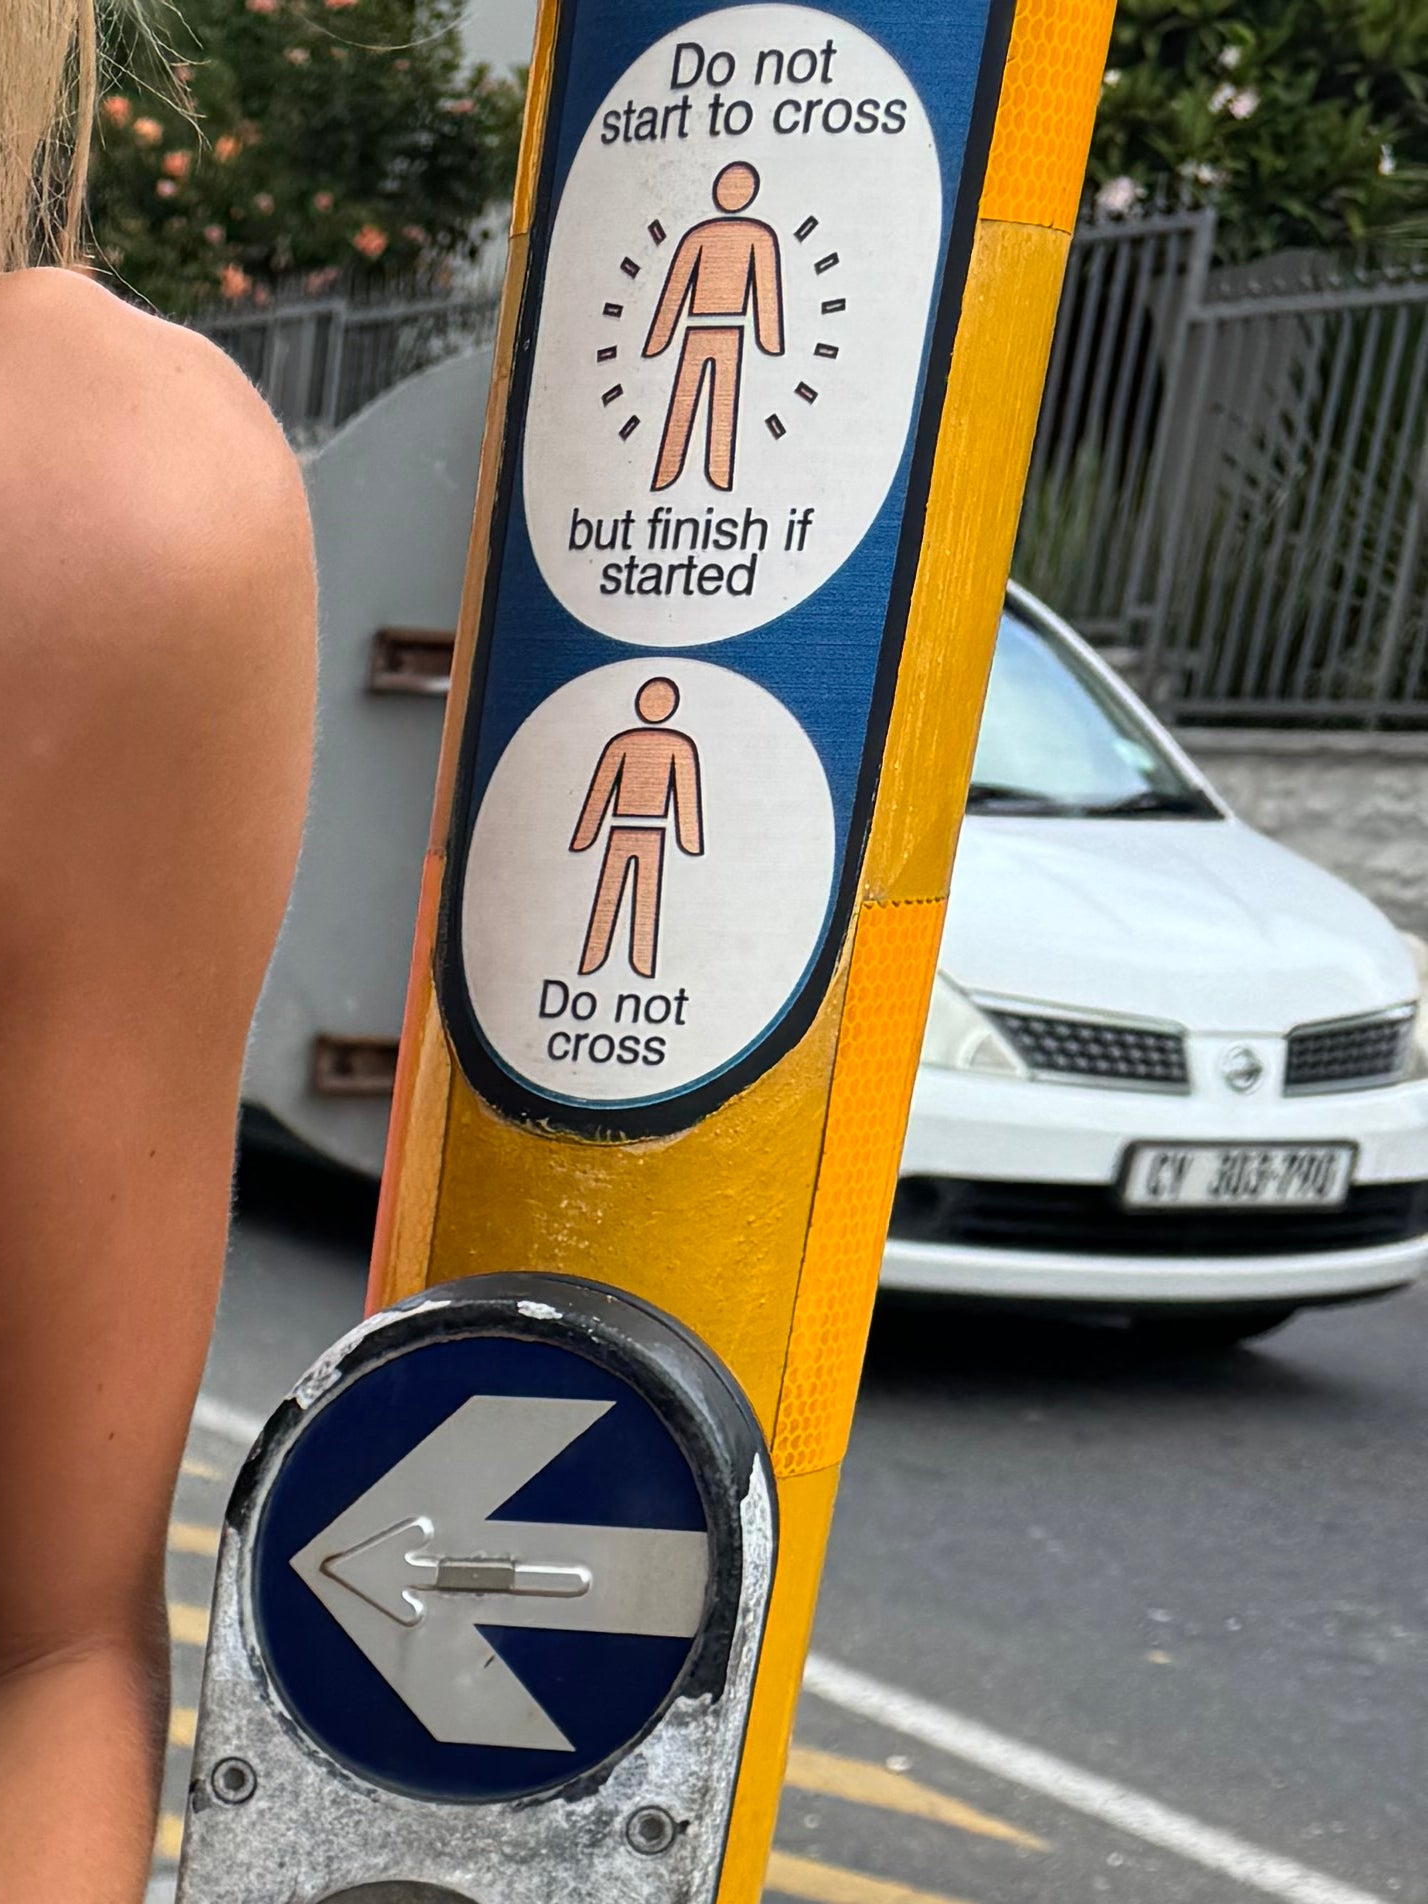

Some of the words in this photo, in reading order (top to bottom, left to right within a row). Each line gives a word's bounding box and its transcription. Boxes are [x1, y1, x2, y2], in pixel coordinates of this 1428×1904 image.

[669, 41, 737, 91] Do
[753, 39, 838, 86] not
[599, 93, 694, 146] start
[707, 93, 754, 138] to
[772, 98, 908, 135] cross
[567, 507, 637, 552] but
[646, 506, 769, 551] finish
[783, 506, 816, 553] if
[598, 552, 759, 597] started
[537, 978, 598, 1022] Do
[613, 987, 690, 1027] not
[546, 1030, 667, 1067] cross
